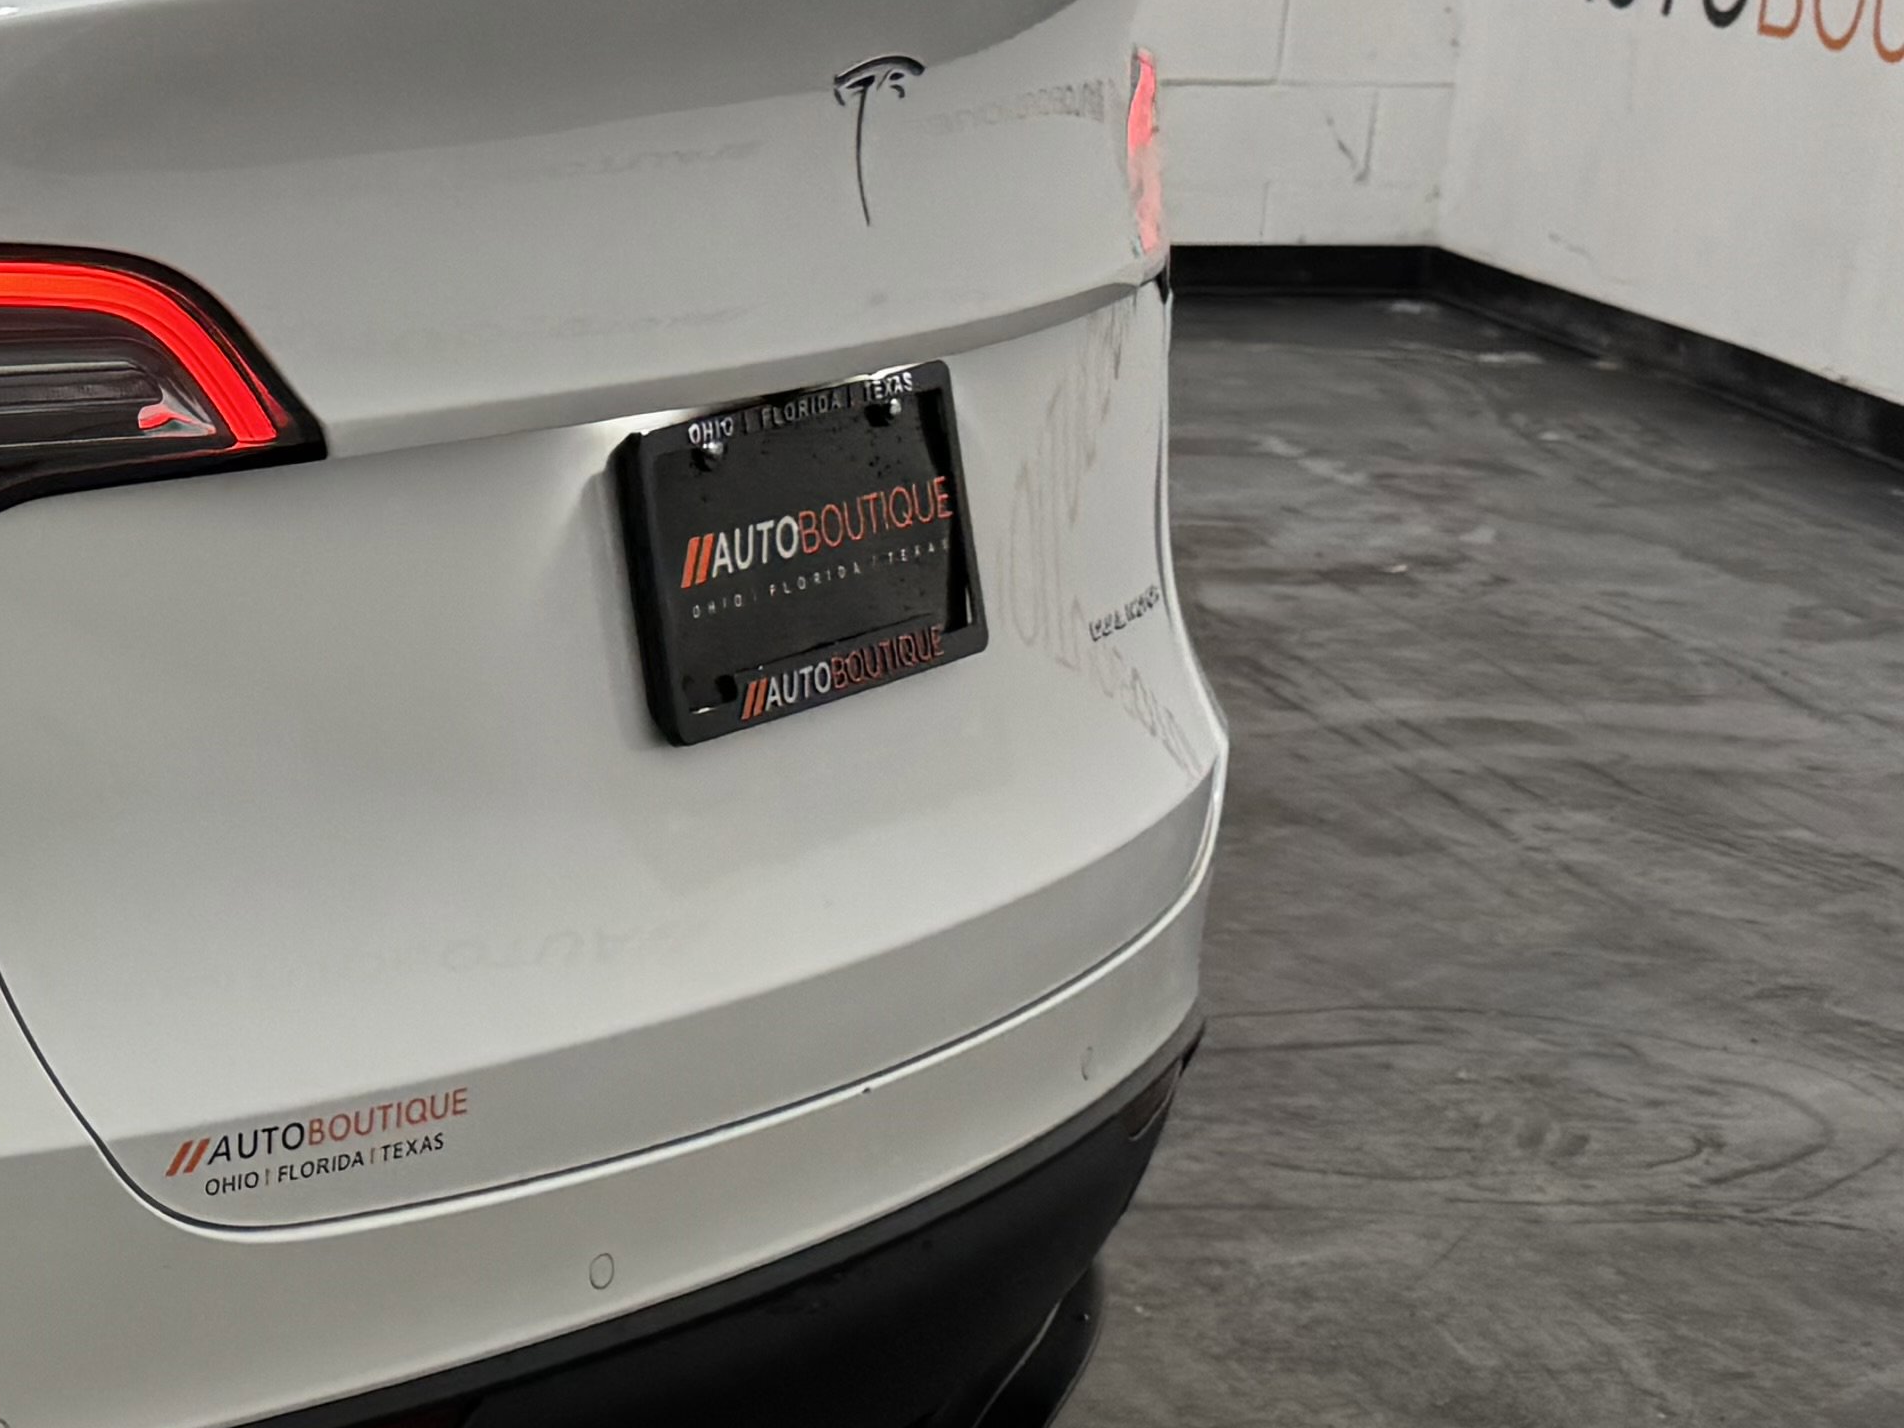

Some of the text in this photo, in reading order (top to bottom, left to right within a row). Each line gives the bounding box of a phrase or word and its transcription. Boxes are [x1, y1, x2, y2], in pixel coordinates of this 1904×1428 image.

[688, 371, 914, 444] OHIO FLORIDA TEXAS
[711, 476, 954, 578] AUTOBOUTIQUE
[692, 594, 743, 619] OHIO
[769, 561, 862, 596] FLORIDA
[765, 624, 945, 712] AUTOBOUTIQUE
[205, 1132, 445, 1197] OHIO FLORIDA TEXAS
[207, 1087, 469, 1166] AUTOBOUTIQUE
